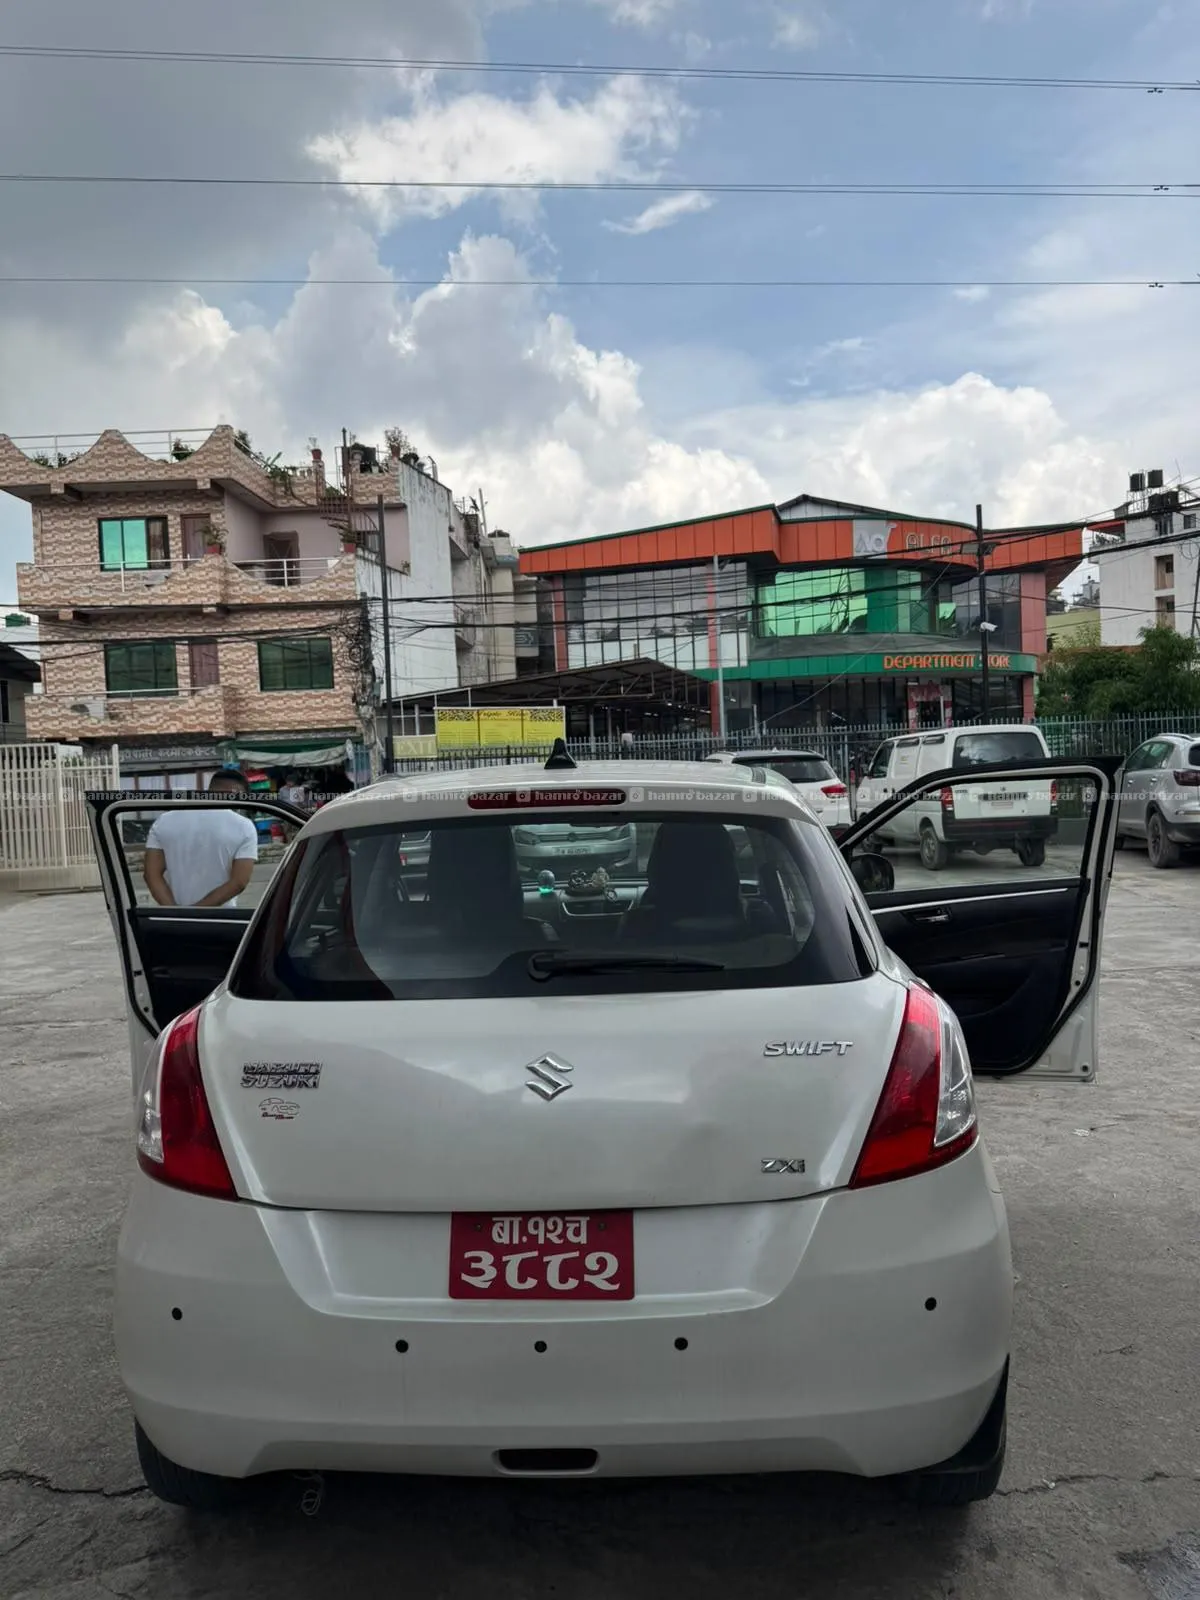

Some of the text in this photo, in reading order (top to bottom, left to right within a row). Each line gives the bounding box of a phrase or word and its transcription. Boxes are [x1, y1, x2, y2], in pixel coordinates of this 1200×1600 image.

[763, 1041, 853, 1057] SWIFT
[240, 1074, 320, 1089] SUZUKI
[460, 1250, 621, 1291] ३८८२
